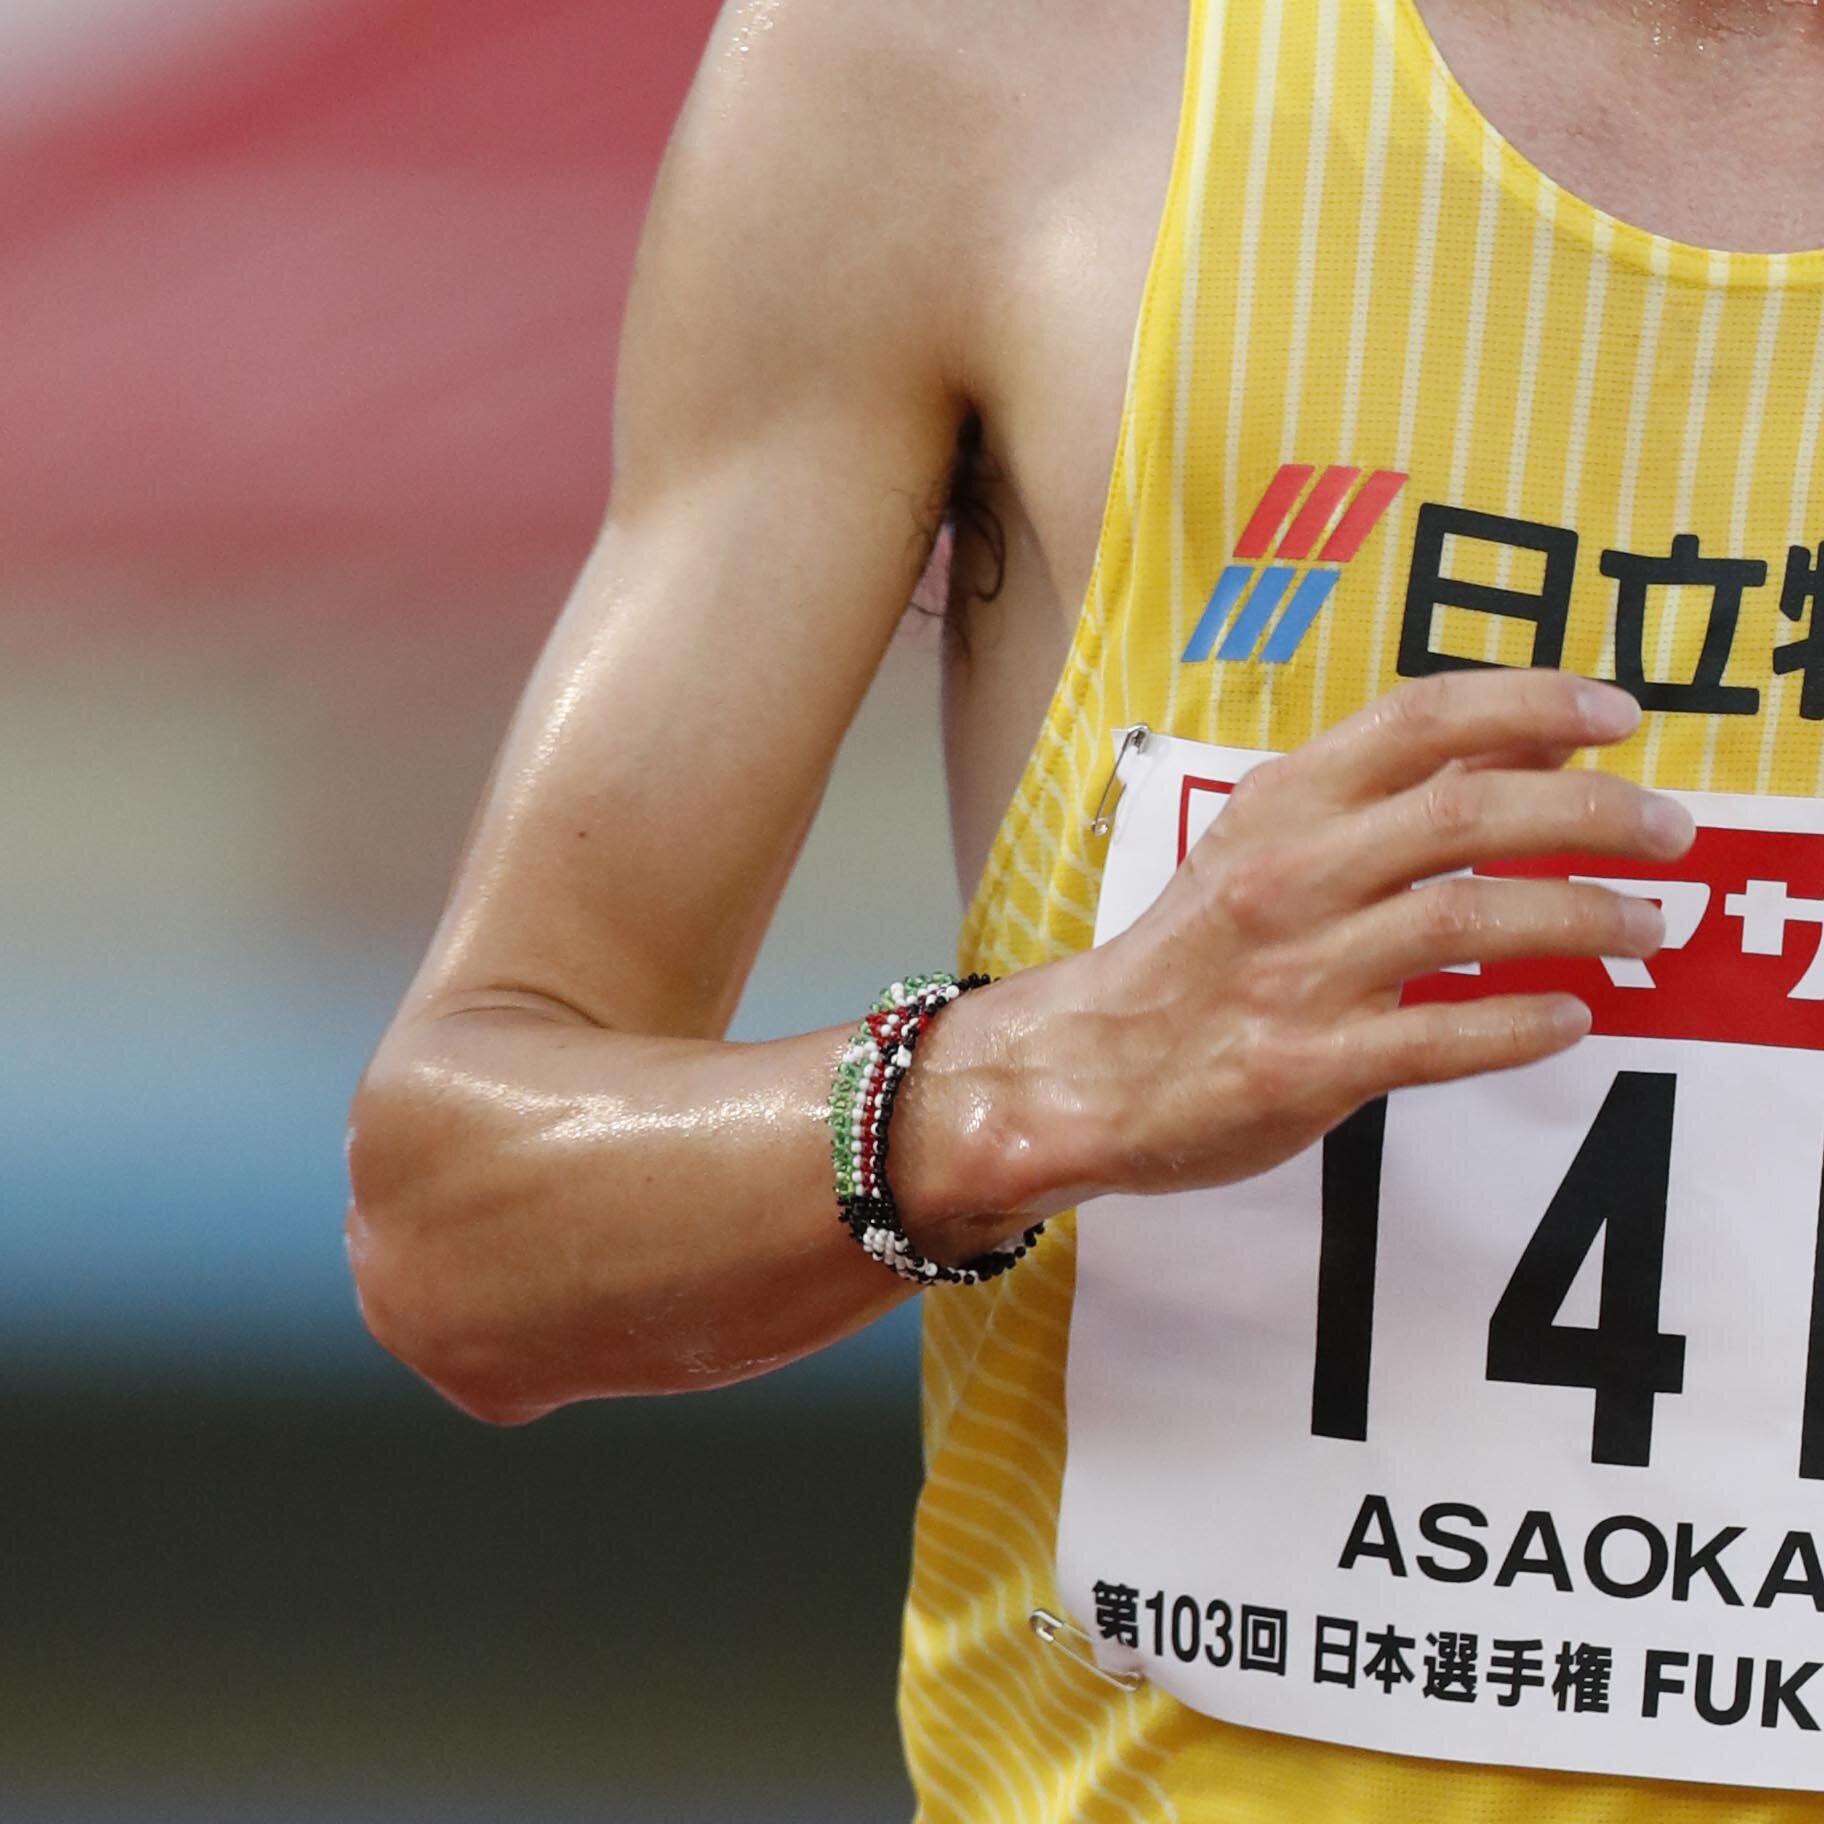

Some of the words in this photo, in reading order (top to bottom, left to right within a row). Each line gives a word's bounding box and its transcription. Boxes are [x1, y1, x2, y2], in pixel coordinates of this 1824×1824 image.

[1091, 1579, 1288, 1677] 第103回
[1313, 1615, 1613, 1714] 日本選手権
